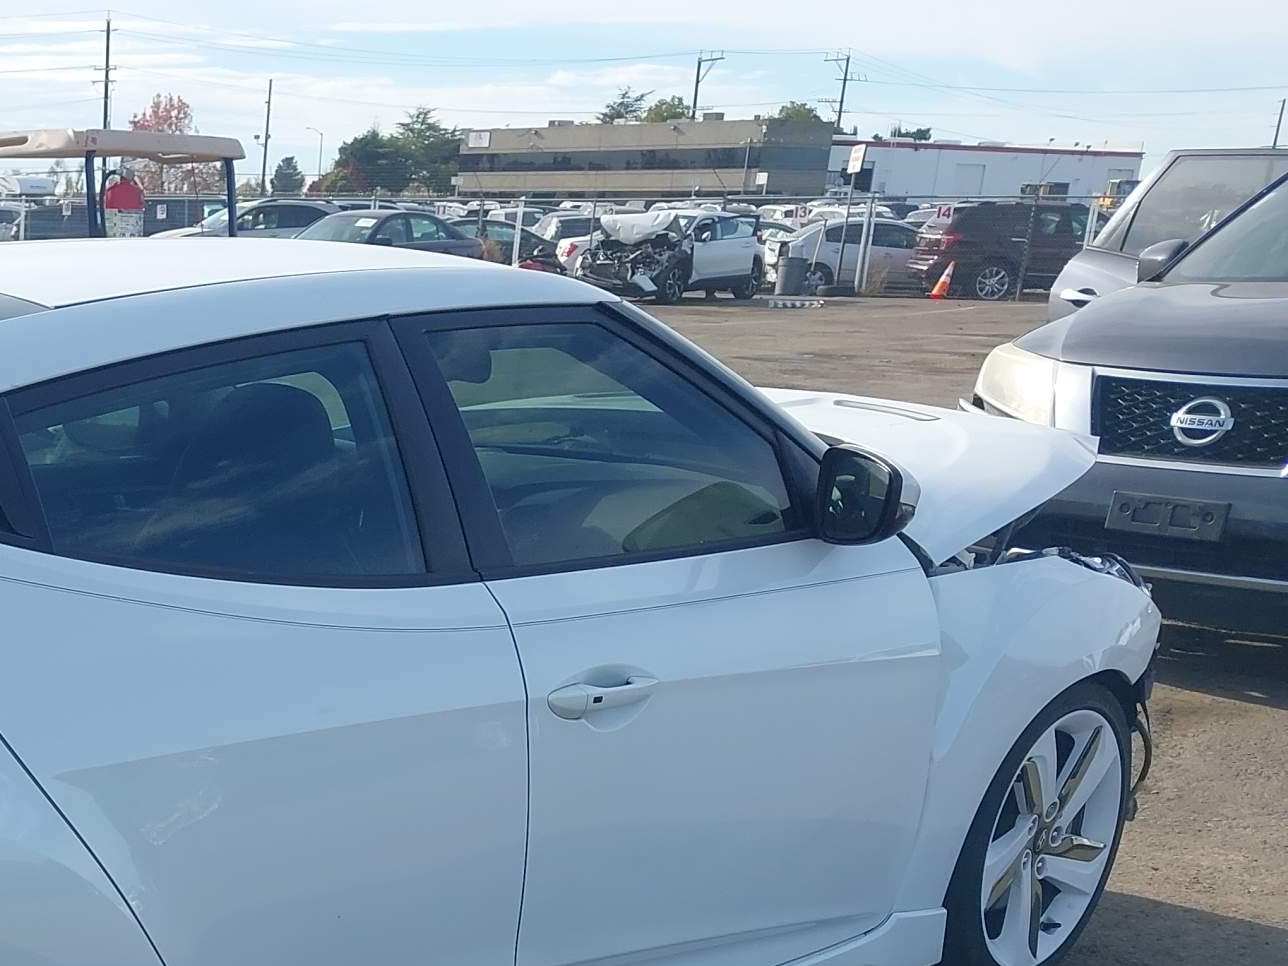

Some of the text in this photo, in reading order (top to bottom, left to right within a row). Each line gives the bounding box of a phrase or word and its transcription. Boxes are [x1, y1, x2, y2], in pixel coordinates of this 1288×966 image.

[794, 206, 807, 219] 13
[936, 206, 951, 219] 14
[1175, 416, 1226, 428] NISSAN
